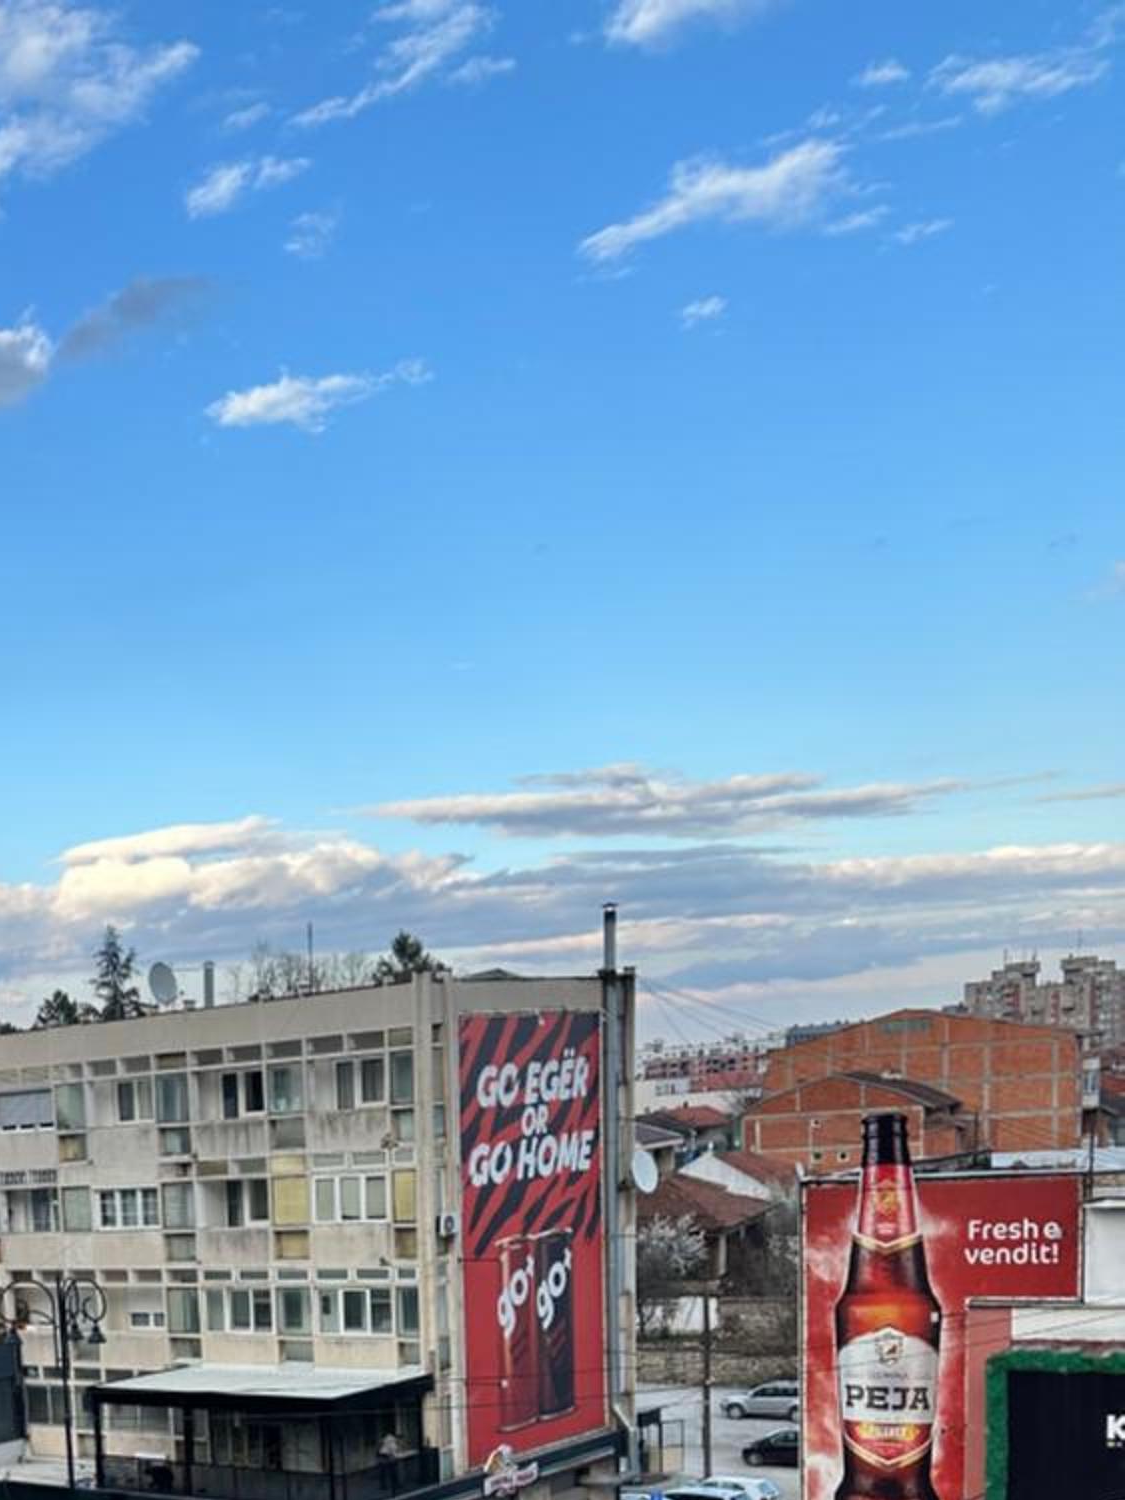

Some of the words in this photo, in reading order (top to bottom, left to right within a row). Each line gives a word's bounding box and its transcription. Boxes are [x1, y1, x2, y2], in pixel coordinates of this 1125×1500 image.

[476, 1062, 518, 1108] GO
[524, 1047, 590, 1105] EGËR
[521, 1104, 549, 1137] OR
[468, 1141, 513, 1187] GO
[516, 1130, 594, 1181] HOME
[967, 1217, 1040, 1240] Fresh
[1042, 1221, 1063, 1240] e
[963, 1241, 1059, 1265] vendit!
[844, 1384, 931, 1411] PEJA
